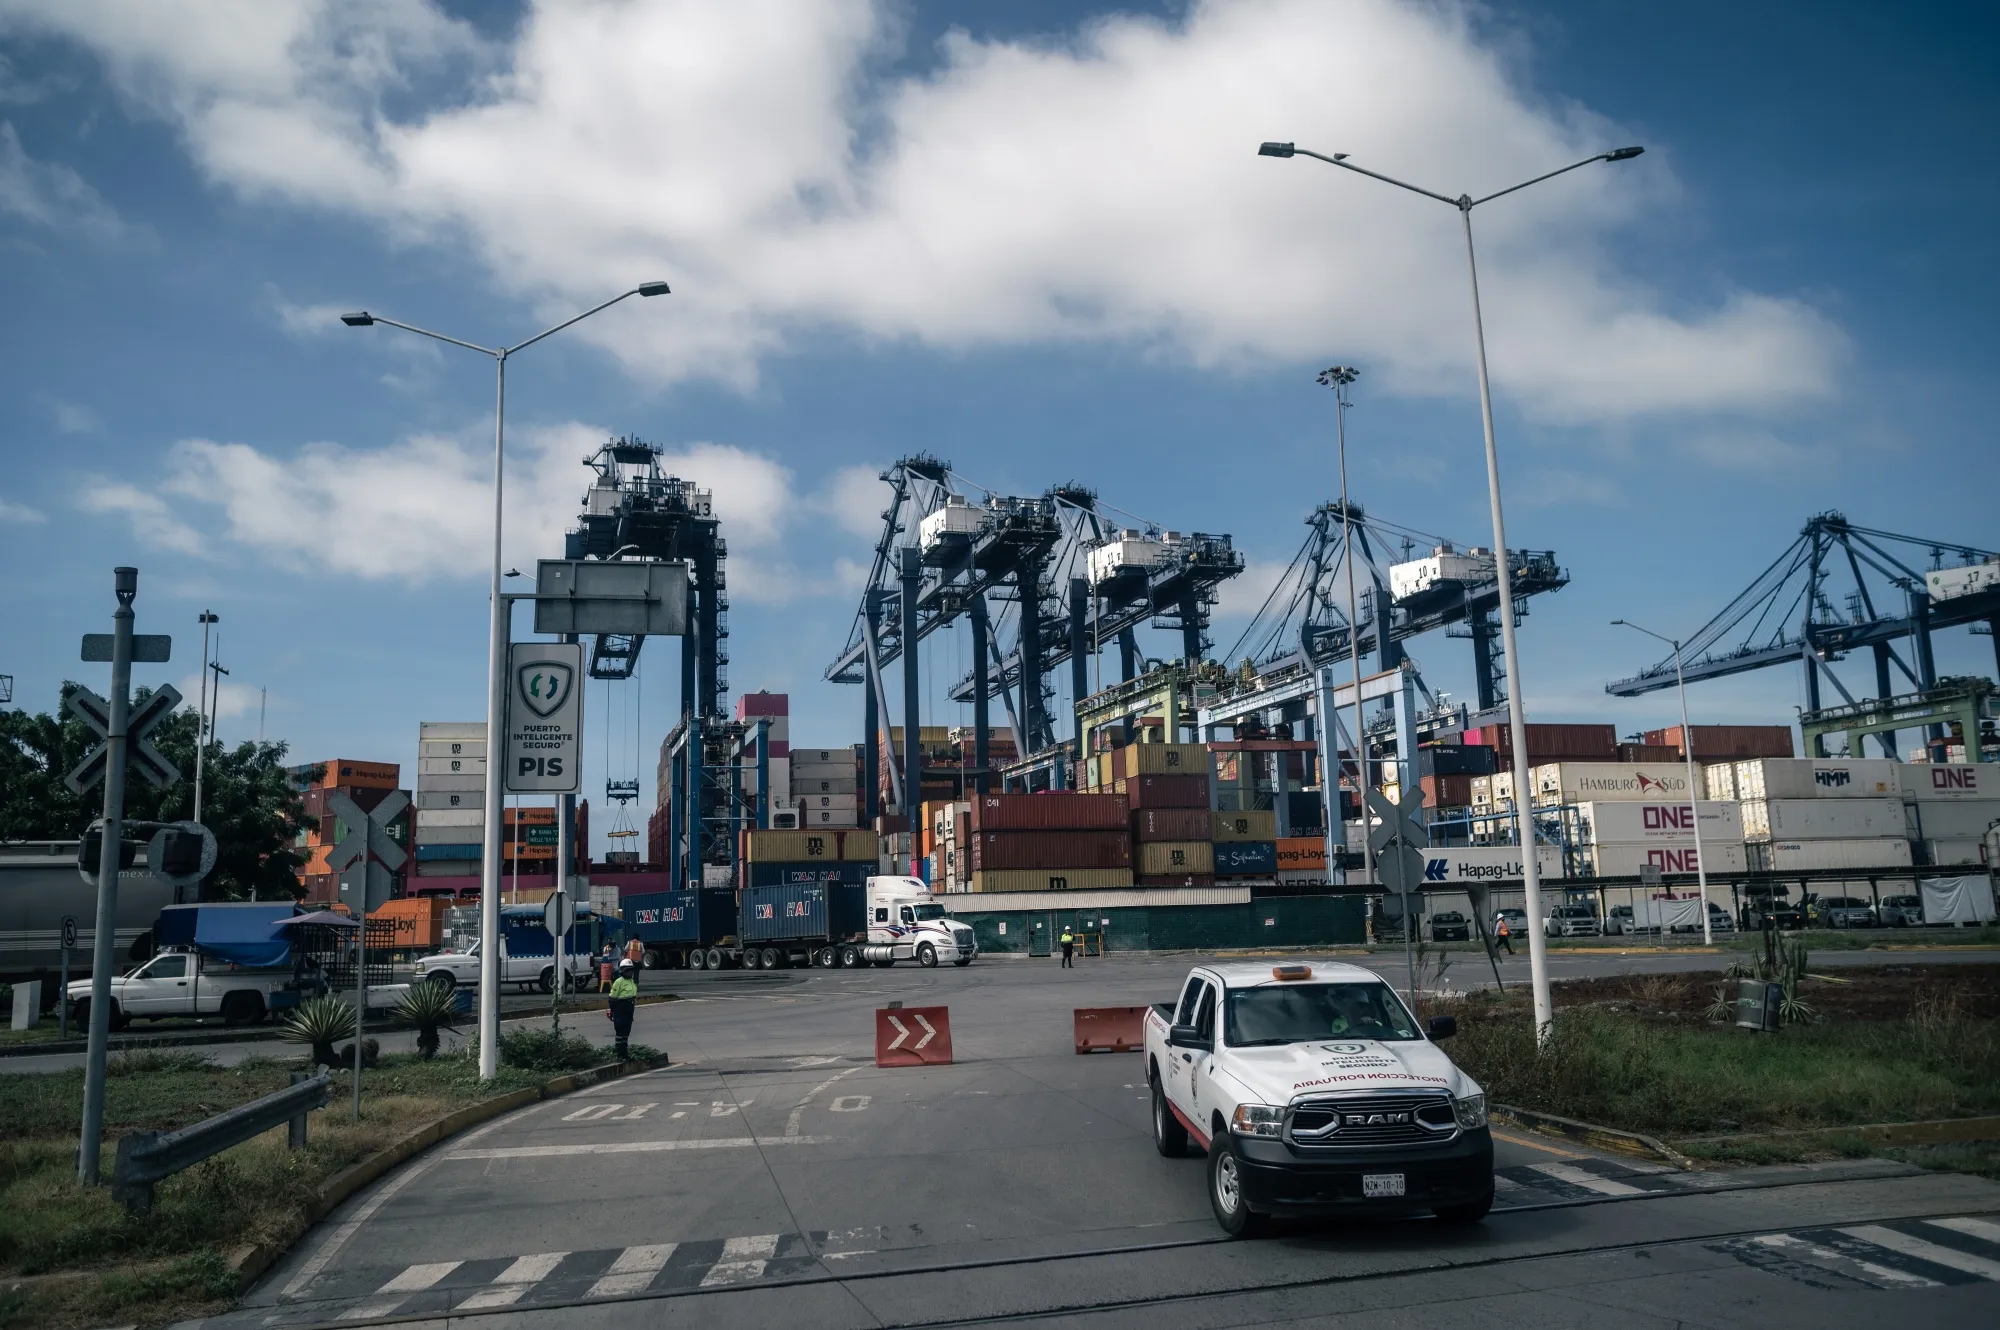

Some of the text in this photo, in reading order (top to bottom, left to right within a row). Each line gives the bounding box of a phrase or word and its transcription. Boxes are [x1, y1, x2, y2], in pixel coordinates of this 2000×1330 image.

[695, 502, 711, 517] 13
[1418, 565, 1428, 579] 10
[1967, 570, 1980, 584] 17
[513, 733, 573, 741] INTELIGENTE
[356, 768, 397, 780] Hapag-Lloyd
[518, 757, 563, 777] PIS
[1580, 776, 1685, 792] HAMBURG SÜD
[1815, 770, 1850, 787] HMM
[1932, 767, 1977, 789] ONE
[1643, 806, 1695, 829] ONE
[1647, 849, 1699, 873] ONE
[791, 871, 841, 881] WAN HAI
[1458, 862, 1542, 879] Hapag-Llod
[636, 907, 684, 924] WAN HAI
[786, 901, 811, 917] HAI
[1346, 1112, 1409, 1125] RAM
